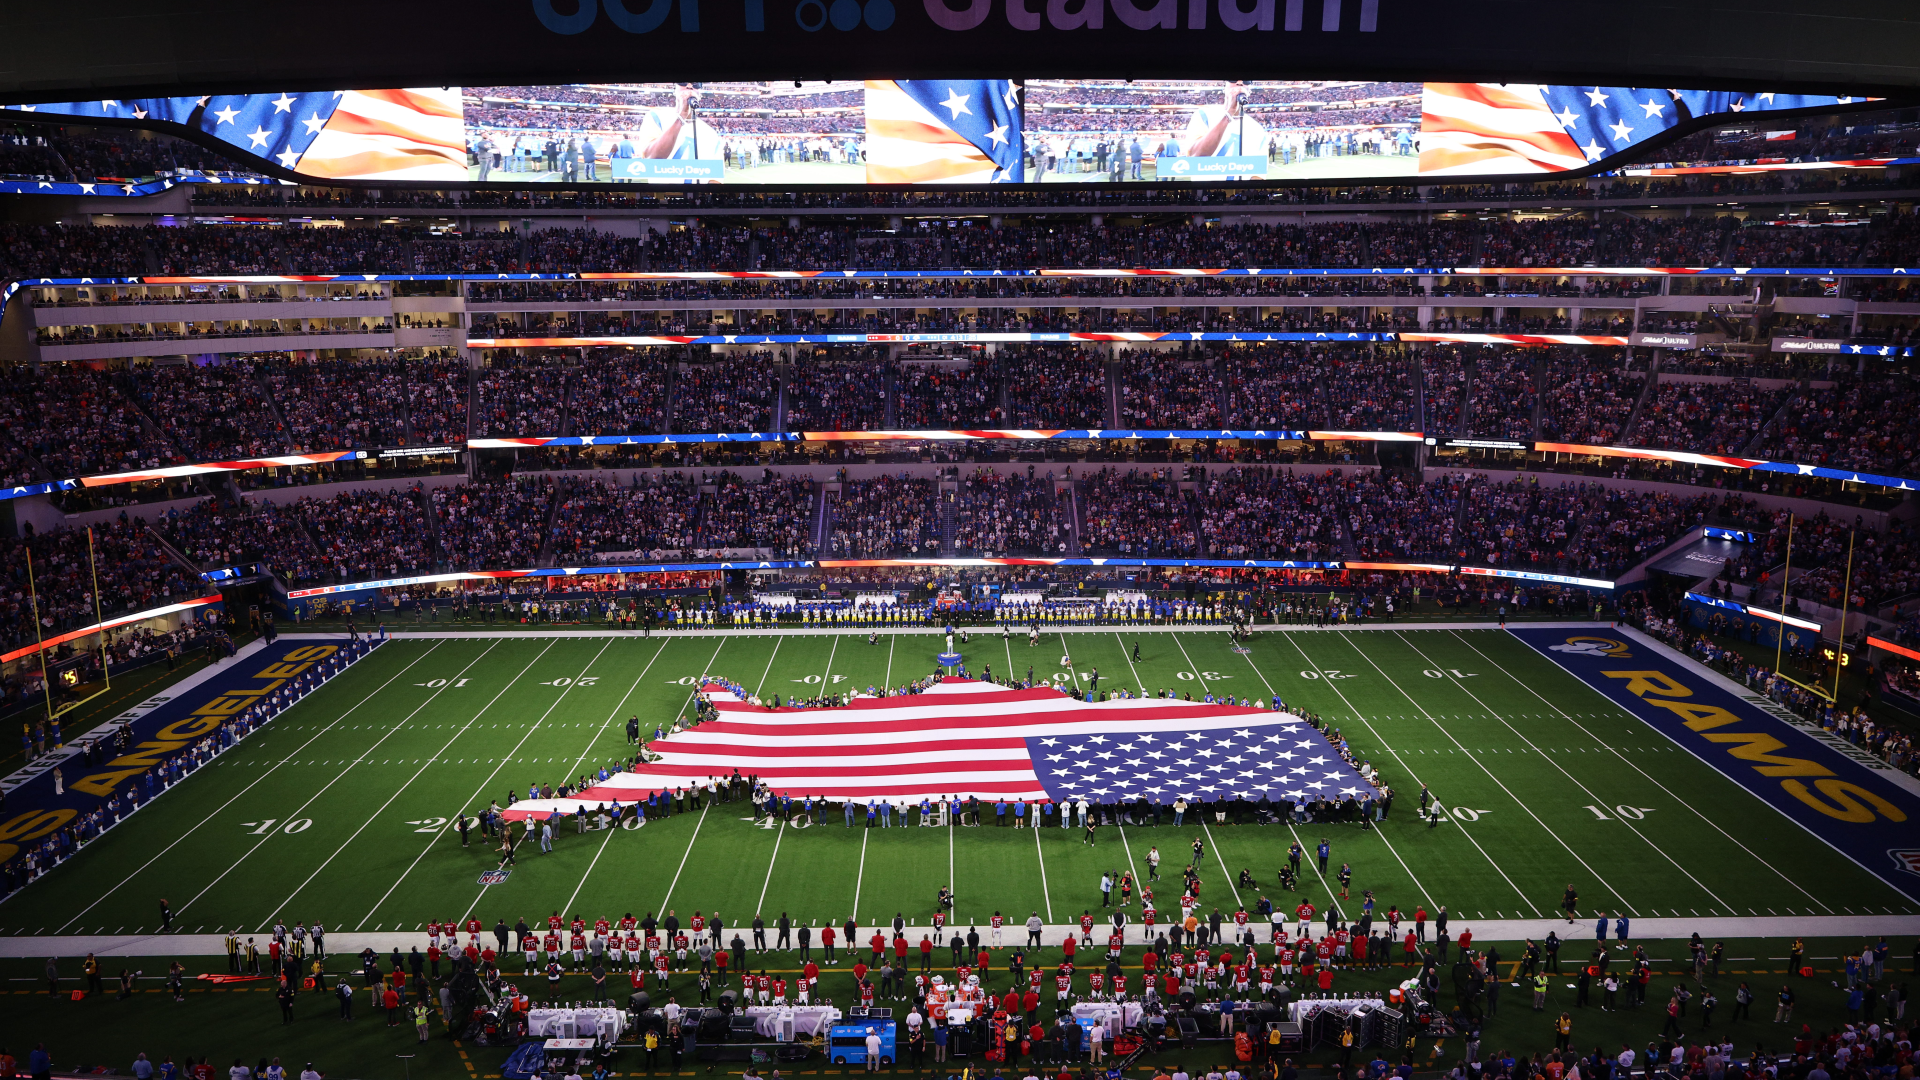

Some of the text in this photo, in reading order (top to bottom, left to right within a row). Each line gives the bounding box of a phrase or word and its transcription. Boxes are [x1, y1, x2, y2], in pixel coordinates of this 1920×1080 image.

[654, 165, 711, 176] Lucky Daye
[1197, 162, 1254, 172] Lucky Daye
[804, 674, 848, 684] 40
[1176, 671, 1222, 681] 30
[1300, 670, 1346, 680] 20
[1422, 669, 1470, 679] 10
[427, 678, 473, 688] 10
[553, 677, 599, 687] 20
[109, 712, 140, 725] OF
[136, 697, 171, 709] US
[68, 645, 339, 797] ANGELES
[1600, 670, 1908, 823] RAMS
[1582, 805, 1646, 821] 10
[247, 818, 313, 835] 10
[414, 817, 481, 833] 20
[753, 813, 815, 830] 40
[550, 921, 559, 929] 77
[525, 941, 536, 949] 70
[657, 960, 666, 968] 81
[1263, 972, 1272, 980] 43
[1591, 967, 1600, 975] 20
[1804, 968, 1813, 977] 10
[304, 978, 313, 987] 20
[1033, 975, 1041, 983] 31
[798, 983, 807, 991] 19
[73, 991, 81, 1000] 10
[934, 1006, 945, 1017] G
[1554, 1069, 1560, 1078] 6
